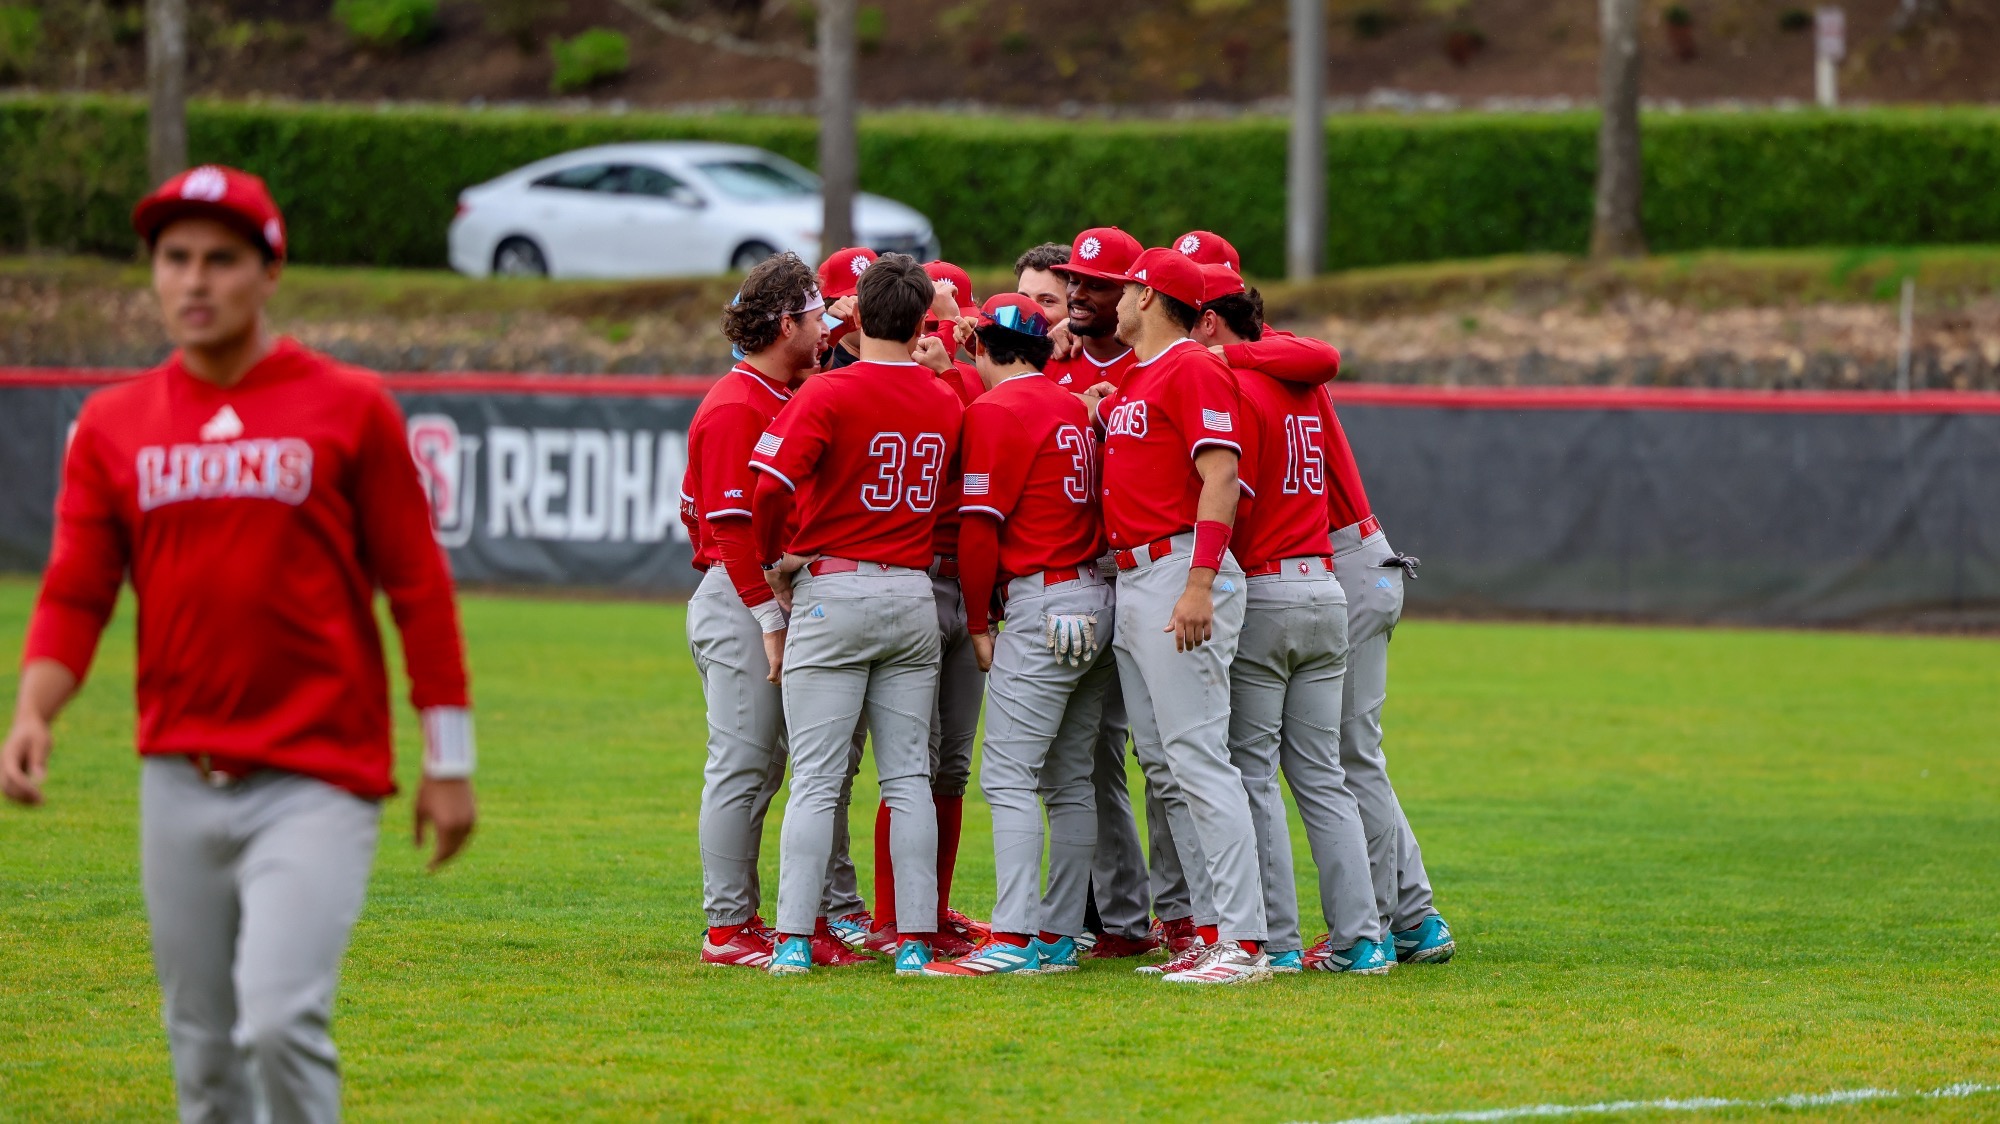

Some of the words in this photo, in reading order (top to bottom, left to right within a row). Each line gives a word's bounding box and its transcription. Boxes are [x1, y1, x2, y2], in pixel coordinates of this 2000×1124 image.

[1105, 400, 1148, 438] ONS
[1283, 414, 1325, 495] 15
[136, 437, 314, 512] LIONS
[724, 489, 743, 498] WCC
[860, 431, 946, 513] 33
